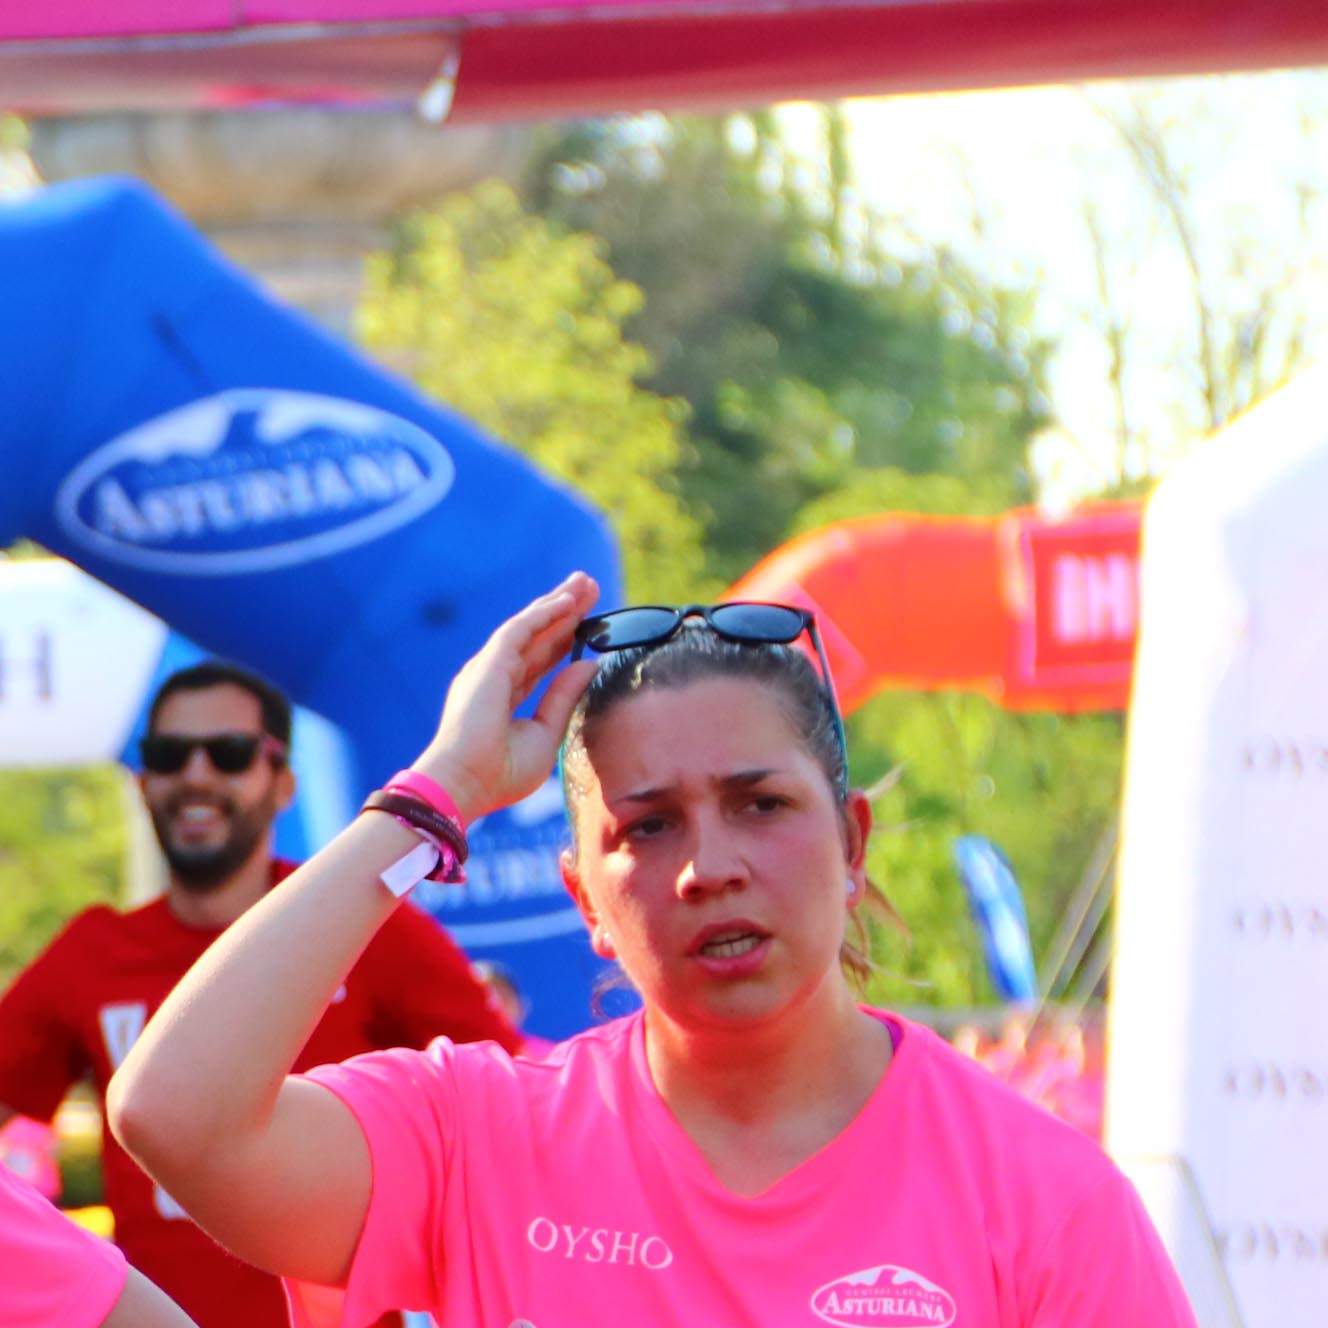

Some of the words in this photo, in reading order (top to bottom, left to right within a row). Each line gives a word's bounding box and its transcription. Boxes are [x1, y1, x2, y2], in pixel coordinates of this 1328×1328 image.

[94, 449, 428, 543] ASTURIANA
[527, 1216, 674, 1270] OYSHO
[822, 1290, 946, 1323] ASTURIANA
